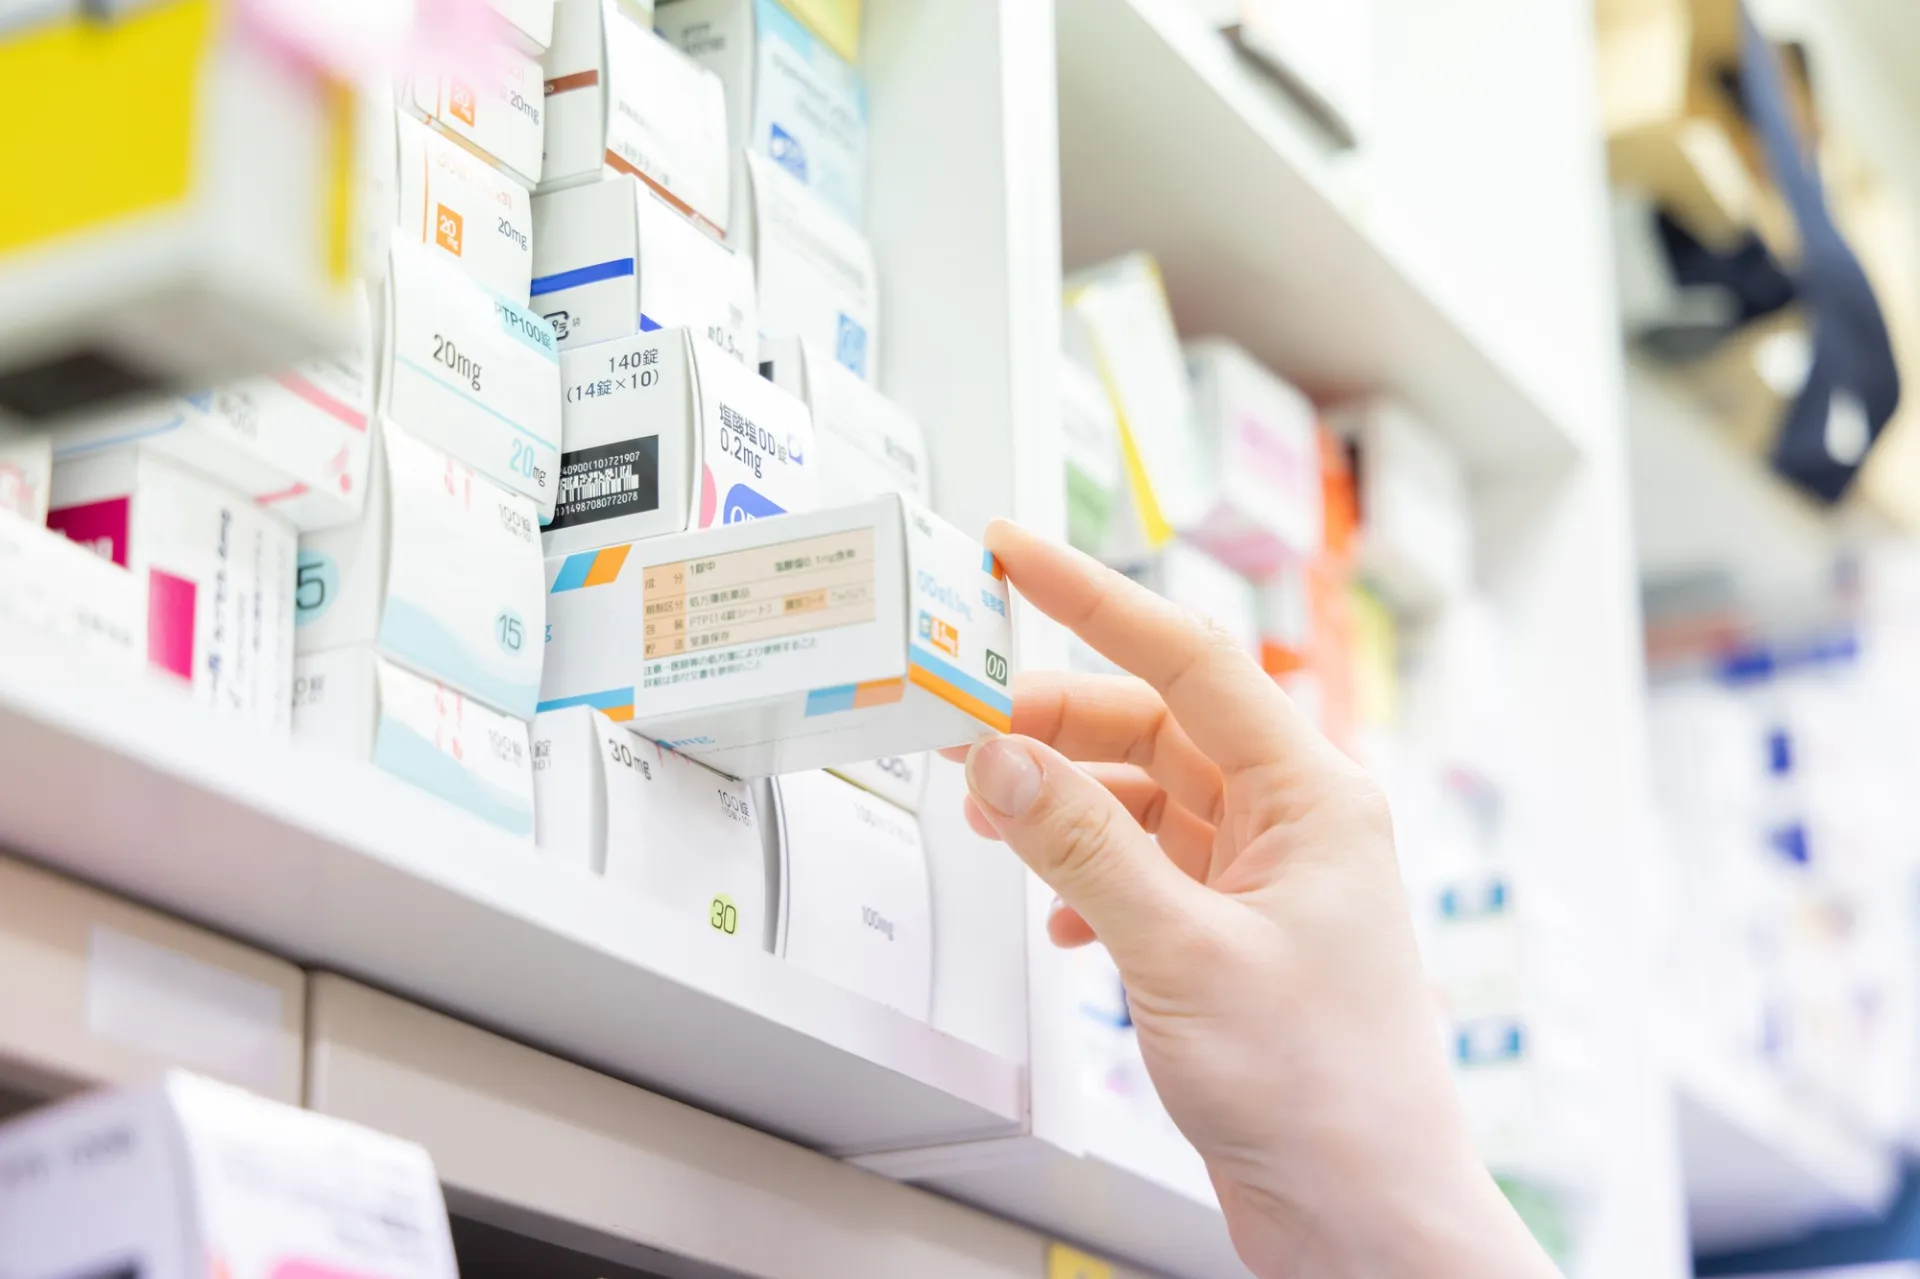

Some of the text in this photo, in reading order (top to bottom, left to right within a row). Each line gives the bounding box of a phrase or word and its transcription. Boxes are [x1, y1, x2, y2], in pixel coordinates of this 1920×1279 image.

[510, 90, 540, 126] 20mg
[439, 214, 457, 238] 20
[497, 216, 528, 252] 20mg
[433, 333, 482, 392] 20mg
[608, 348, 660, 374] 140錠
[559, 451, 641, 477] 40900(10)721907
[720, 426, 763, 480] 0.2mg
[500, 614, 522, 650] 15
[986, 654, 1006, 681] OD
[608, 738, 652, 781] 30mg
[711, 898, 737, 935] 30
